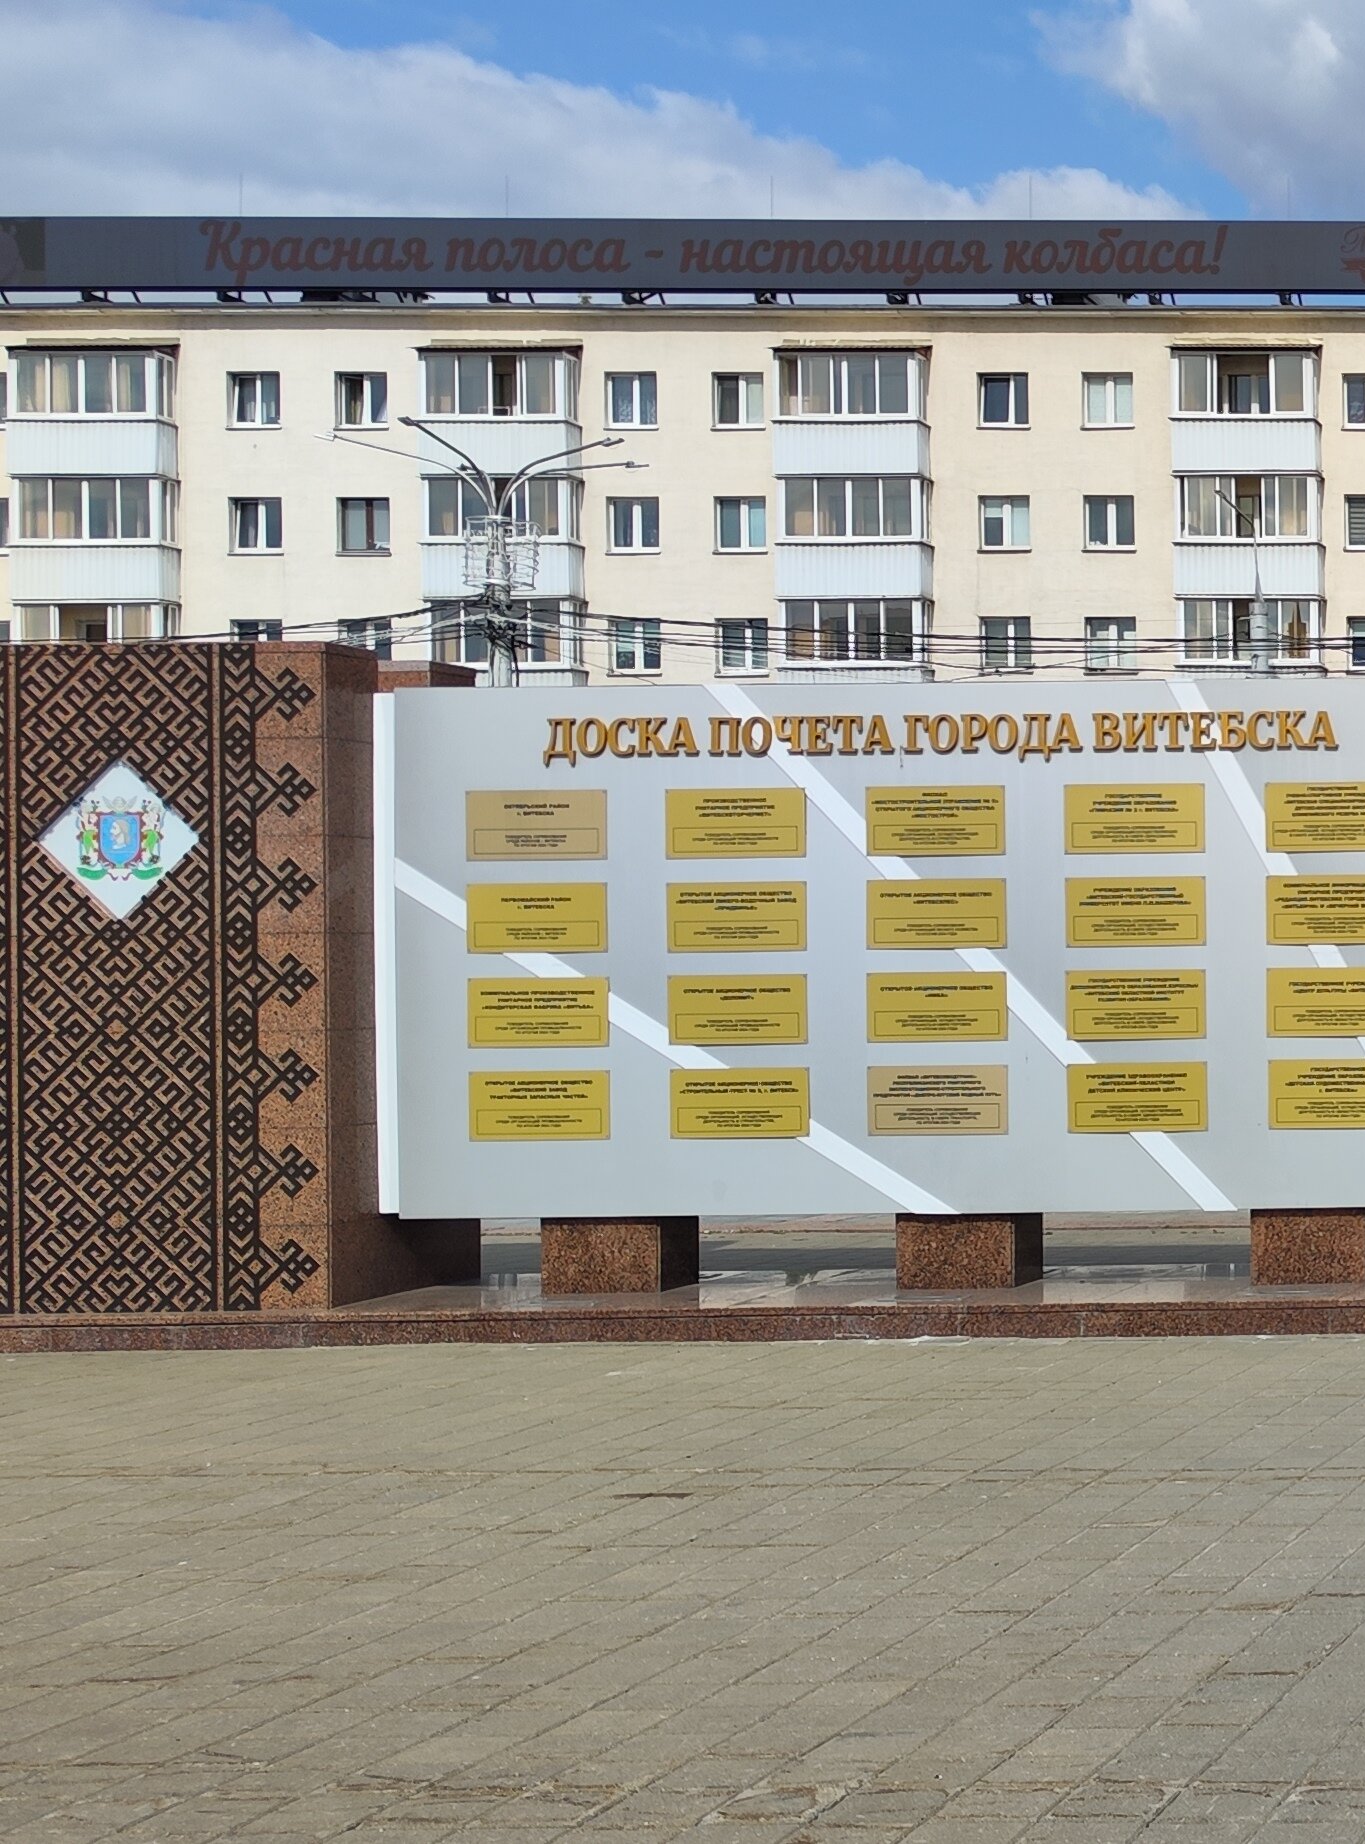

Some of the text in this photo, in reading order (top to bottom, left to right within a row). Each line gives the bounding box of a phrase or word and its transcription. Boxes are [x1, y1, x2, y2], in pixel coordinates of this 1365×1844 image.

[200, 219, 433, 287] Красная
[444, 237, 631, 273] полоса
[679, 238, 993, 285] настоящая
[1003, 224, 1229, 275] колбаса!
[543, 710, 1340, 768] ДОСКА ПОЧЕТА ГОРОДА ВИТЕБСКА
